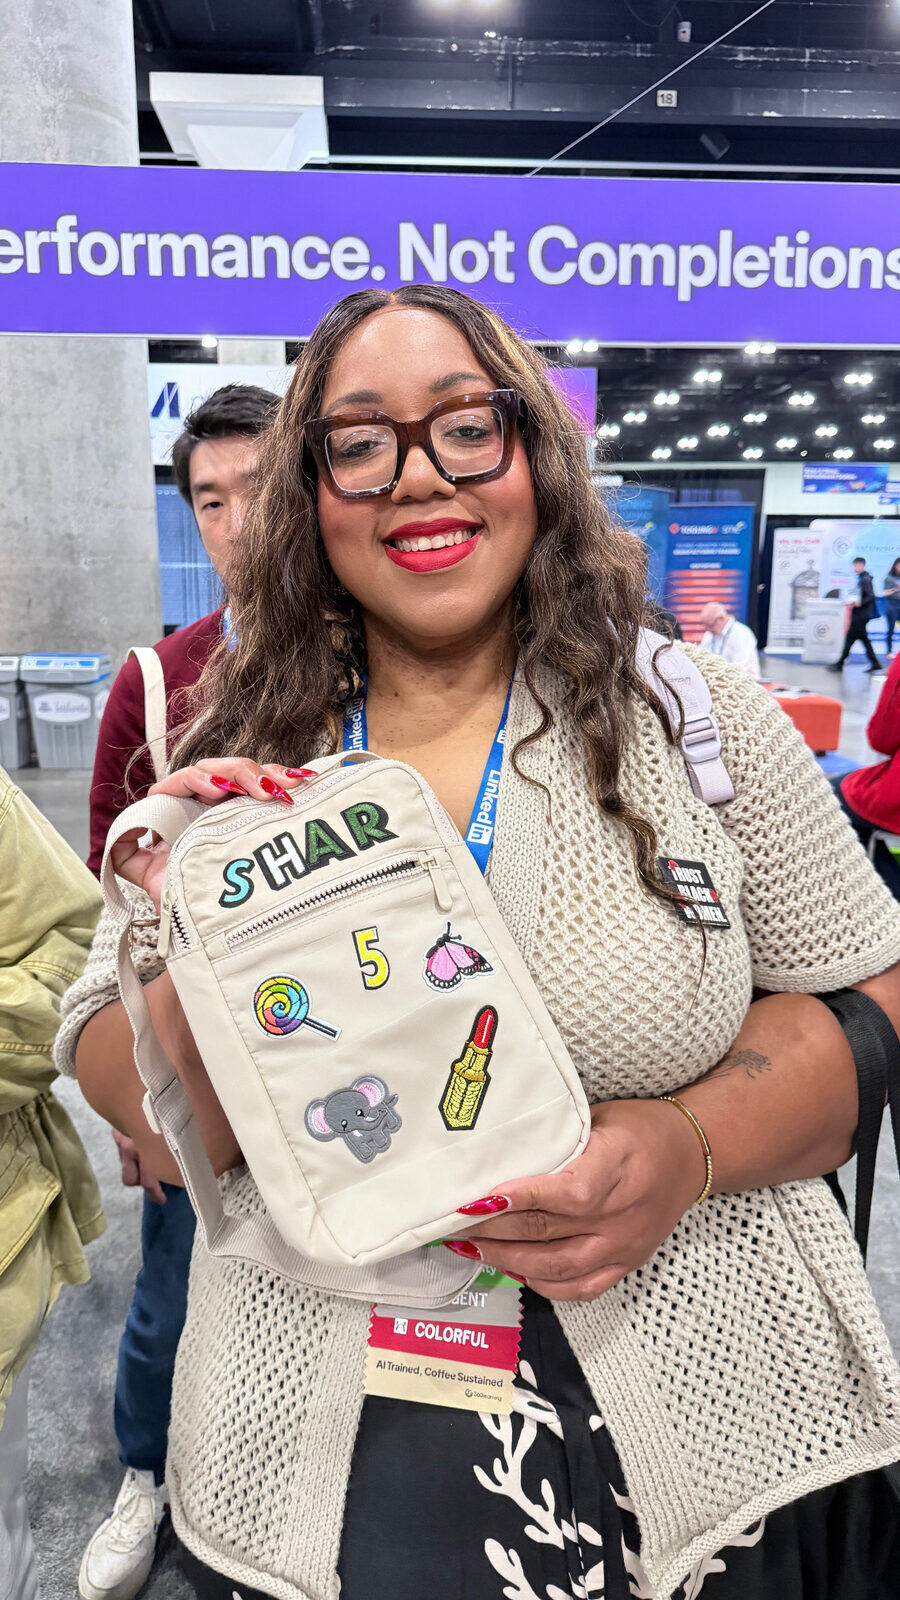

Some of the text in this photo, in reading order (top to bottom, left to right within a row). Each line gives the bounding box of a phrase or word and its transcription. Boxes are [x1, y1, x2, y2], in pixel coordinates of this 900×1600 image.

[660, 93, 674, 104] 18
[399, 222, 516, 284] Not
[218, 802, 400, 909] SHAR
[668, 864, 704, 884] TRUST
[677, 884, 715, 903] BLACK
[352, 926, 391, 991] 5
[415, 1321, 490, 1349] COLORFUL
[376, 1360, 504, 1388] AI Trained, Coffee Sustained
